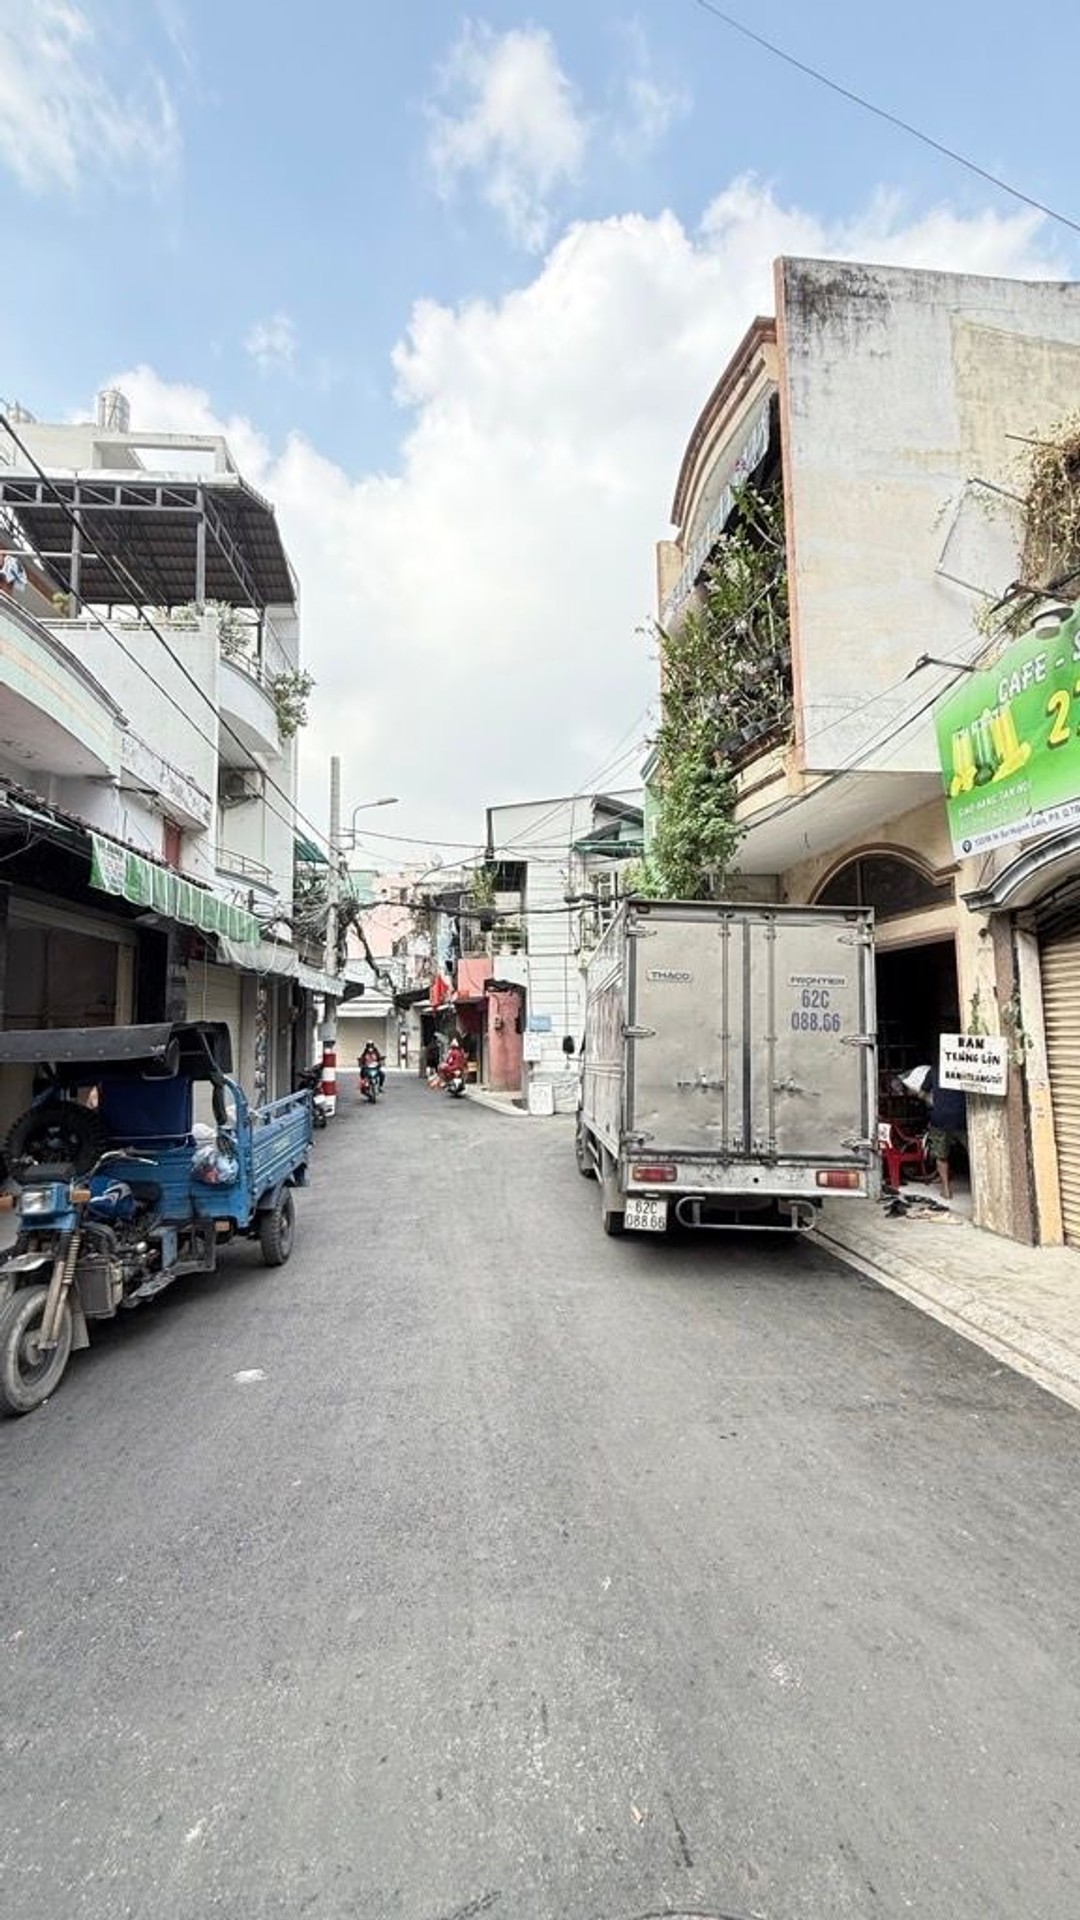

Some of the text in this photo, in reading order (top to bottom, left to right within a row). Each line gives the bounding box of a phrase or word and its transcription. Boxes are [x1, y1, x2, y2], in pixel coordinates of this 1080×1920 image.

[998, 652, 1047, 703] CAFE
[651, 971, 691, 982] THACO
[789, 976, 846, 986] FRONTIER
[802, 990, 830, 1008] 62C
[791, 1012, 841, 1032] 088.66
[635, 1200, 658, 1214] 62C
